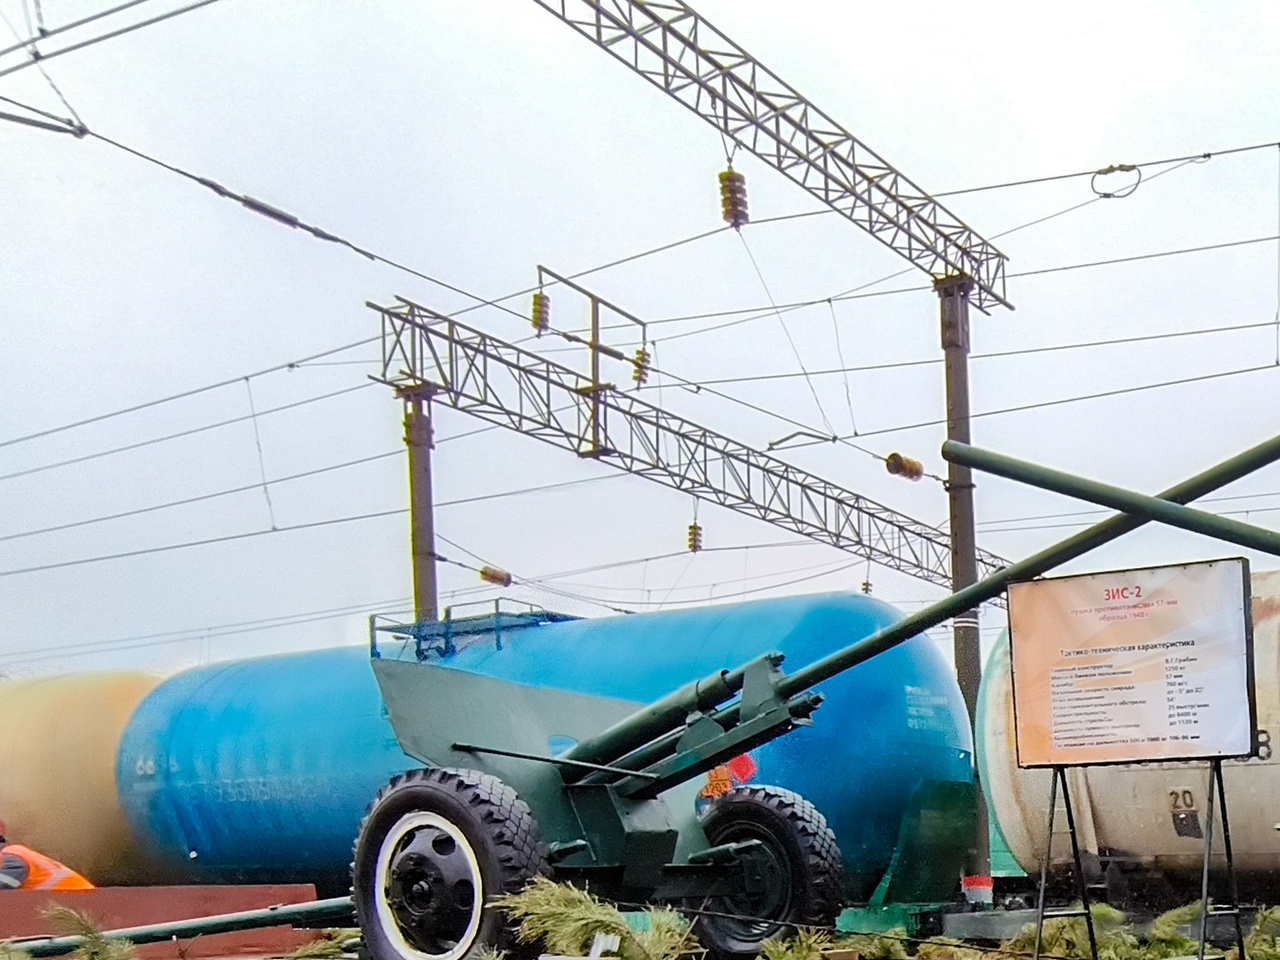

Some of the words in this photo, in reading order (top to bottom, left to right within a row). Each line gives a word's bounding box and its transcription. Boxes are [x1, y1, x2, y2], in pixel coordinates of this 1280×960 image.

[1104, 585, 1142, 601] ЗИС-2
[1137, 639, 1196, 652] характеристика
[1169, 789, 1195, 810] 20
